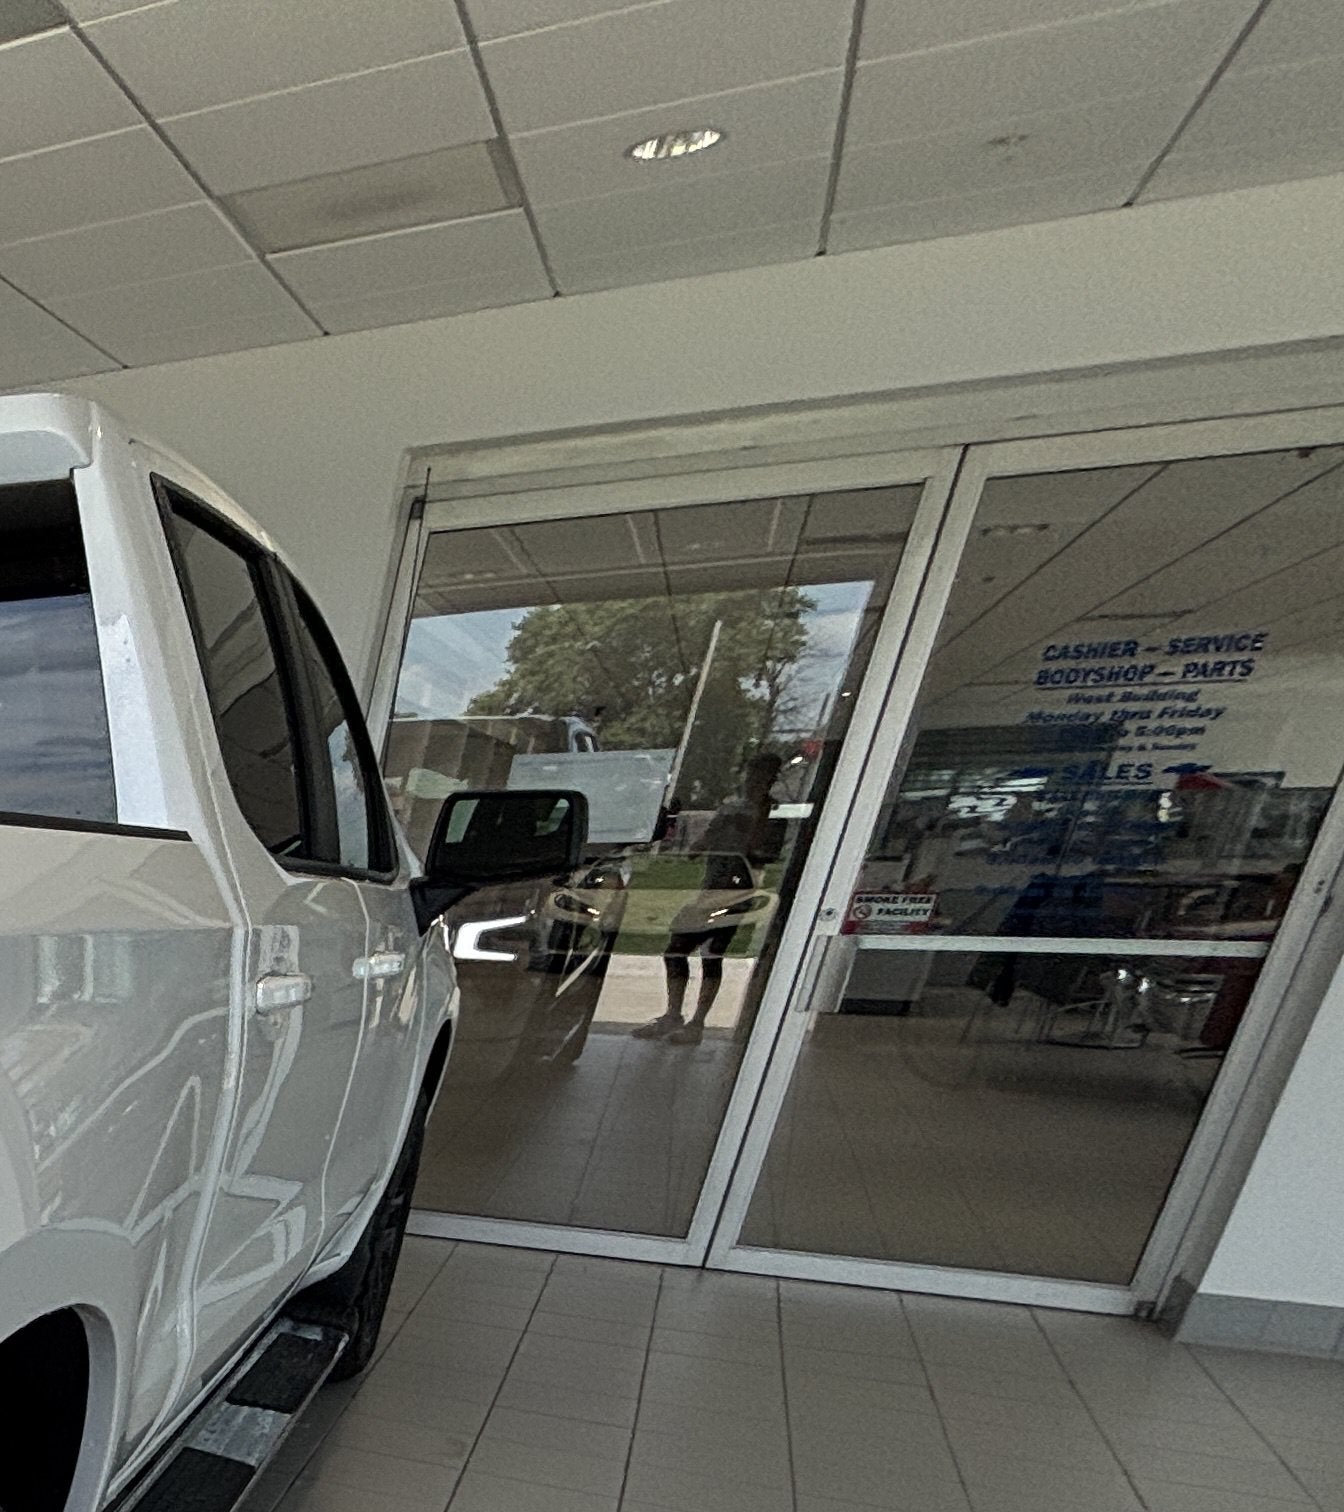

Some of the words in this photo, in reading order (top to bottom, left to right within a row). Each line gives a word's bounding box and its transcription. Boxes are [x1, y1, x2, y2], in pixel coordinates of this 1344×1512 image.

[1042, 639, 1139, 662] CASHIER
[1165, 633, 1269, 656] SERVICE
[1034, 664, 1156, 686] BODYSHOP
[1180, 658, 1256, 680] PARTS
[1024, 710, 1104, 725] Monday
[1111, 707, 1152, 722] thru
[1157, 706, 1228, 721] Friday
[1060, 760, 1154, 781] SALES
[855, 895, 899, 905] SMOKE
[875, 907, 930, 917] FACILITY
